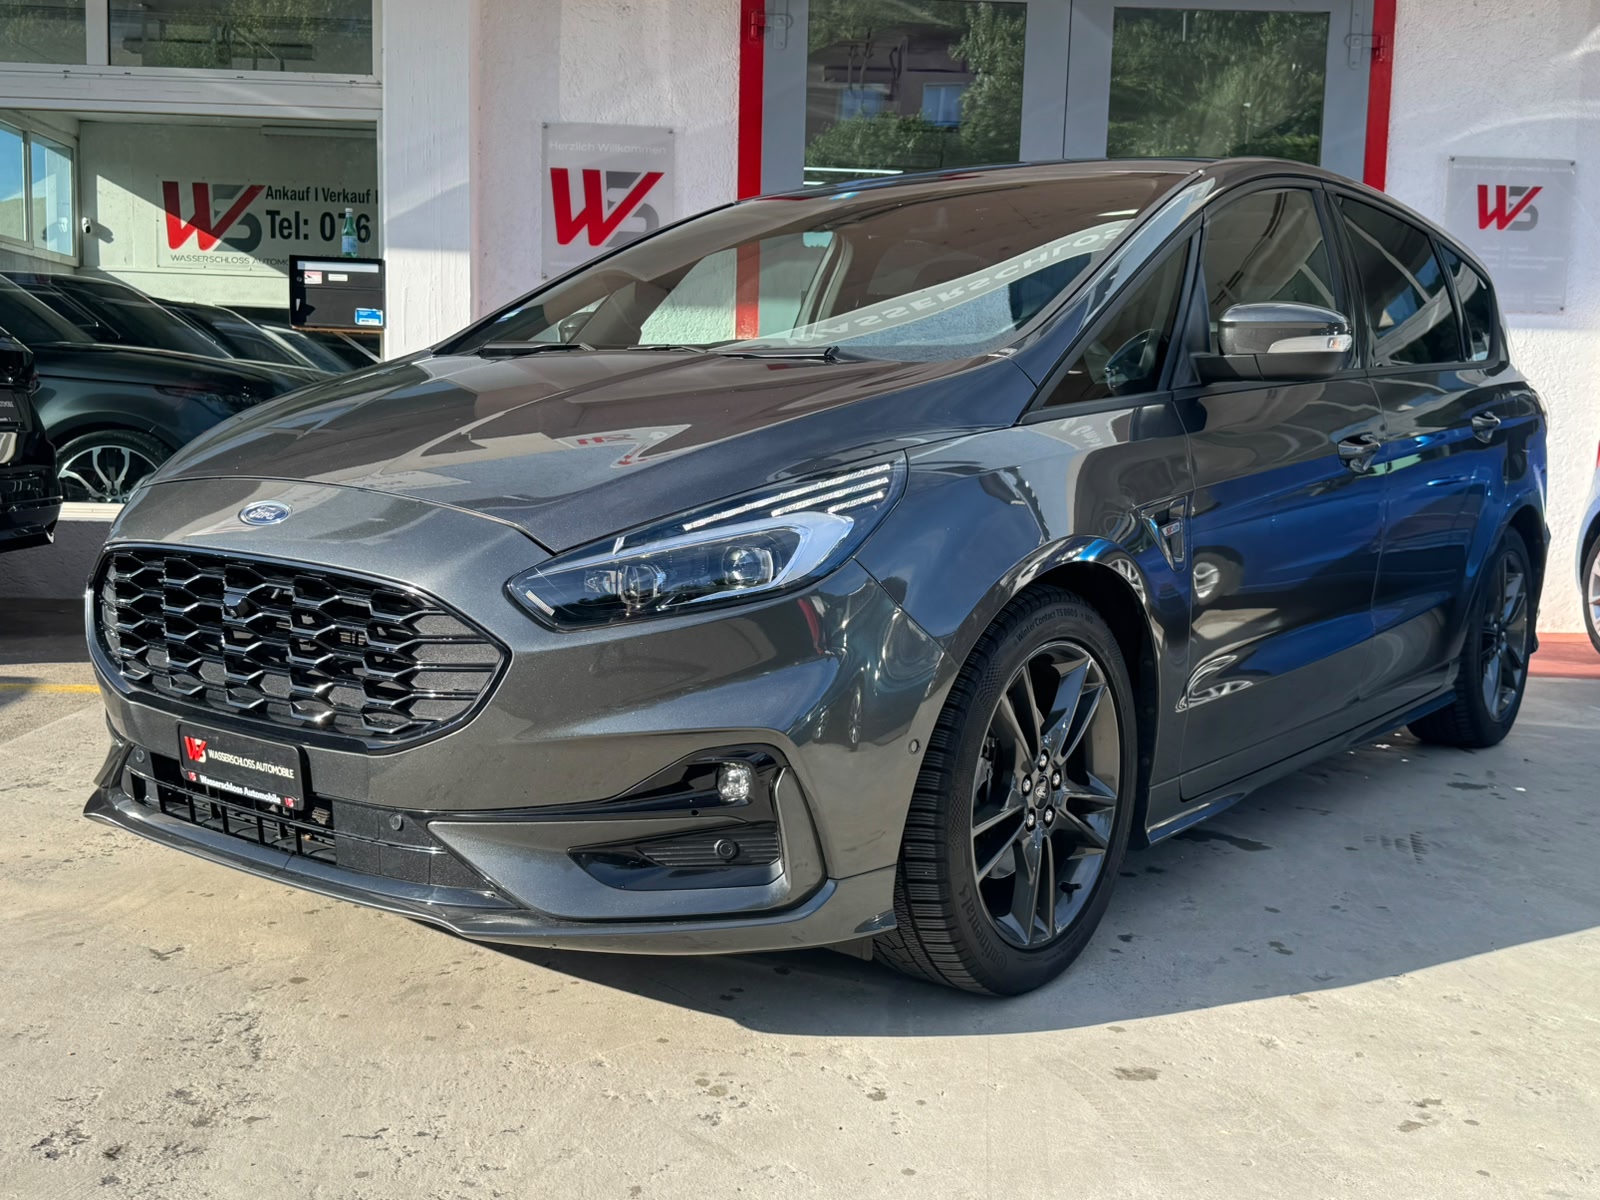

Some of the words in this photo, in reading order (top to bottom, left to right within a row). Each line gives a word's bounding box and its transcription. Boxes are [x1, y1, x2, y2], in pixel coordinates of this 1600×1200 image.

[549, 141, 595, 153] Herzlich
[598, 143, 666, 154] Willkommen
[265, 185, 311, 202] Ankauf
[322, 187, 371, 204] Verkauf
[265, 209, 309, 240] Tel:
[170, 254, 250, 265] WASSERSCHLOSS
[208, 749, 255, 769] WASSERSCHLOSS
[255, 762, 295, 779] AUTOMOBILE
[199, 775, 243, 794] Wasserschloss
[244, 787, 281, 804] Automobile
